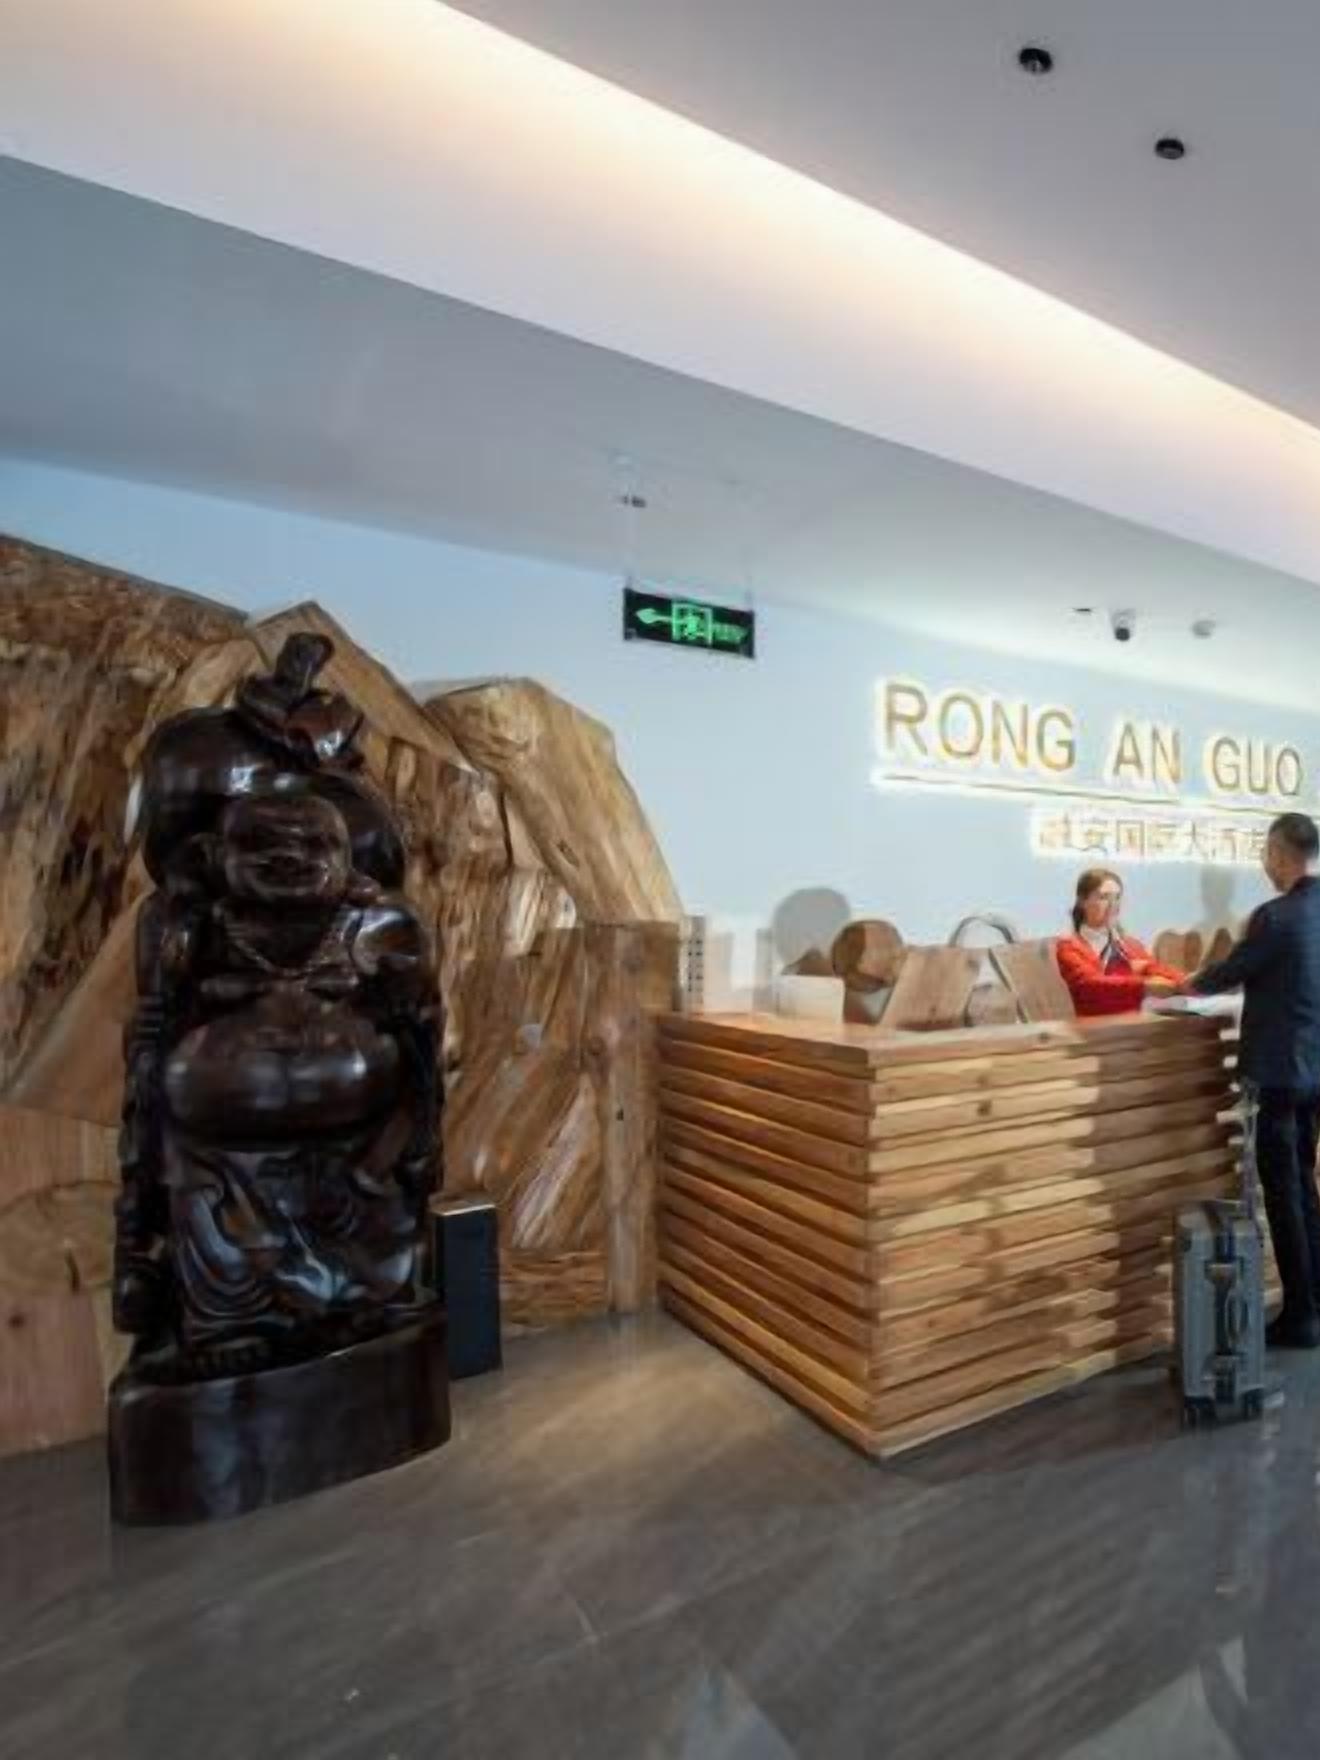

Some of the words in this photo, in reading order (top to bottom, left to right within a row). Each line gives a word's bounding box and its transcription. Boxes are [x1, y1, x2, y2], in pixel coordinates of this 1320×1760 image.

[885, 682, 1076, 773] RONG
[1112, 721, 1182, 785] AN
[1212, 736, 1302, 797] GUO
